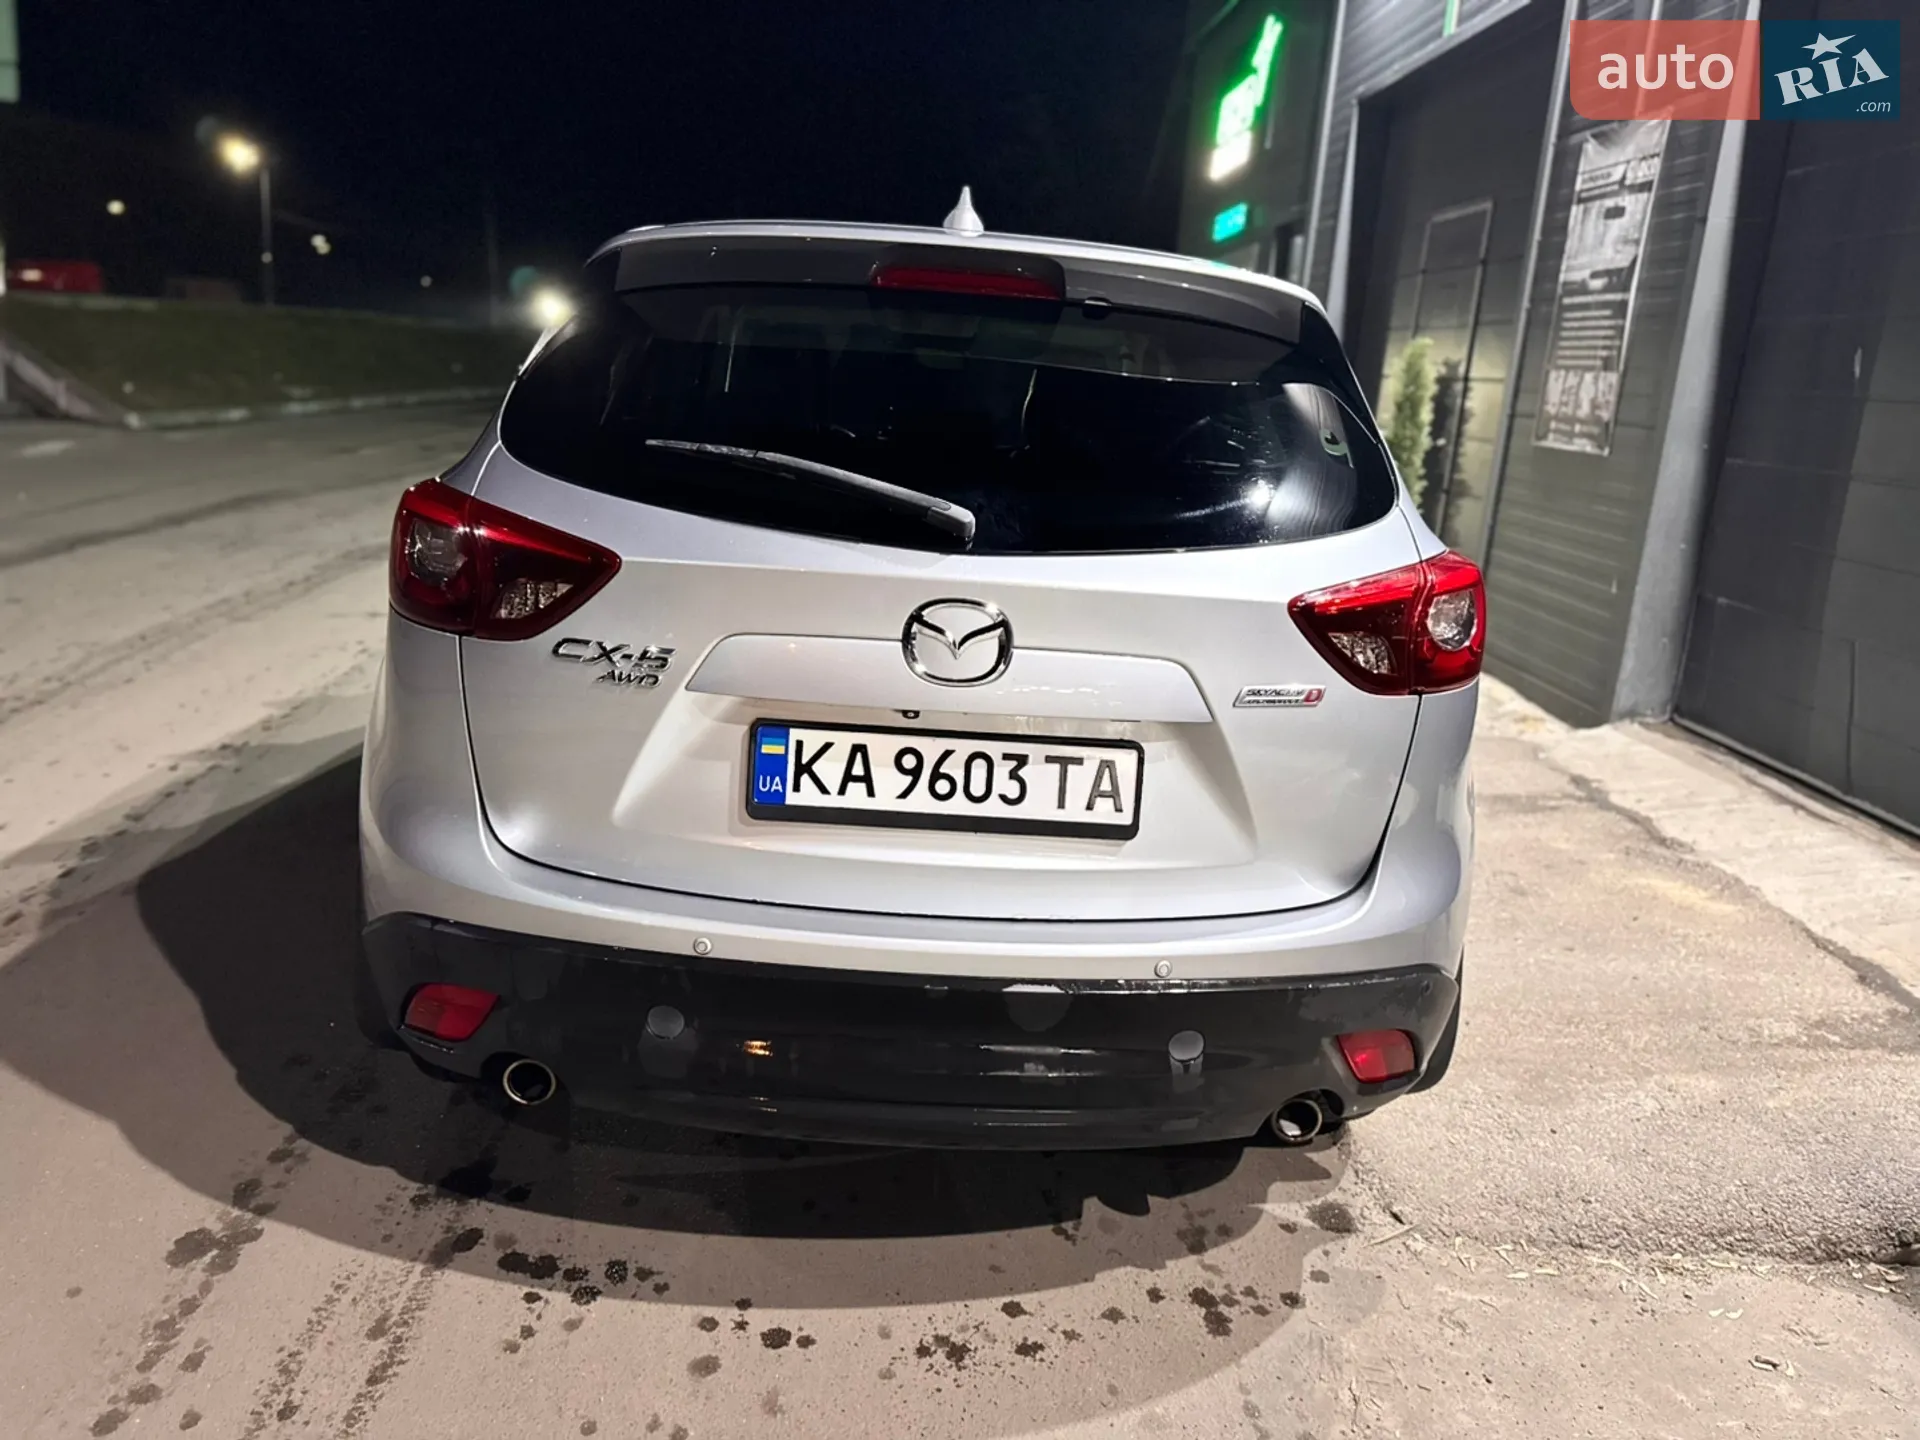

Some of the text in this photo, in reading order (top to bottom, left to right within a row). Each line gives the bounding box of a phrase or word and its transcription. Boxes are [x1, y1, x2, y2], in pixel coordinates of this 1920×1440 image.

[552, 637, 676, 671] CX-5
[596, 669, 662, 687] AWD
[759, 775, 783, 793] UA
[792, 739, 1124, 813] KA 9603 TA
